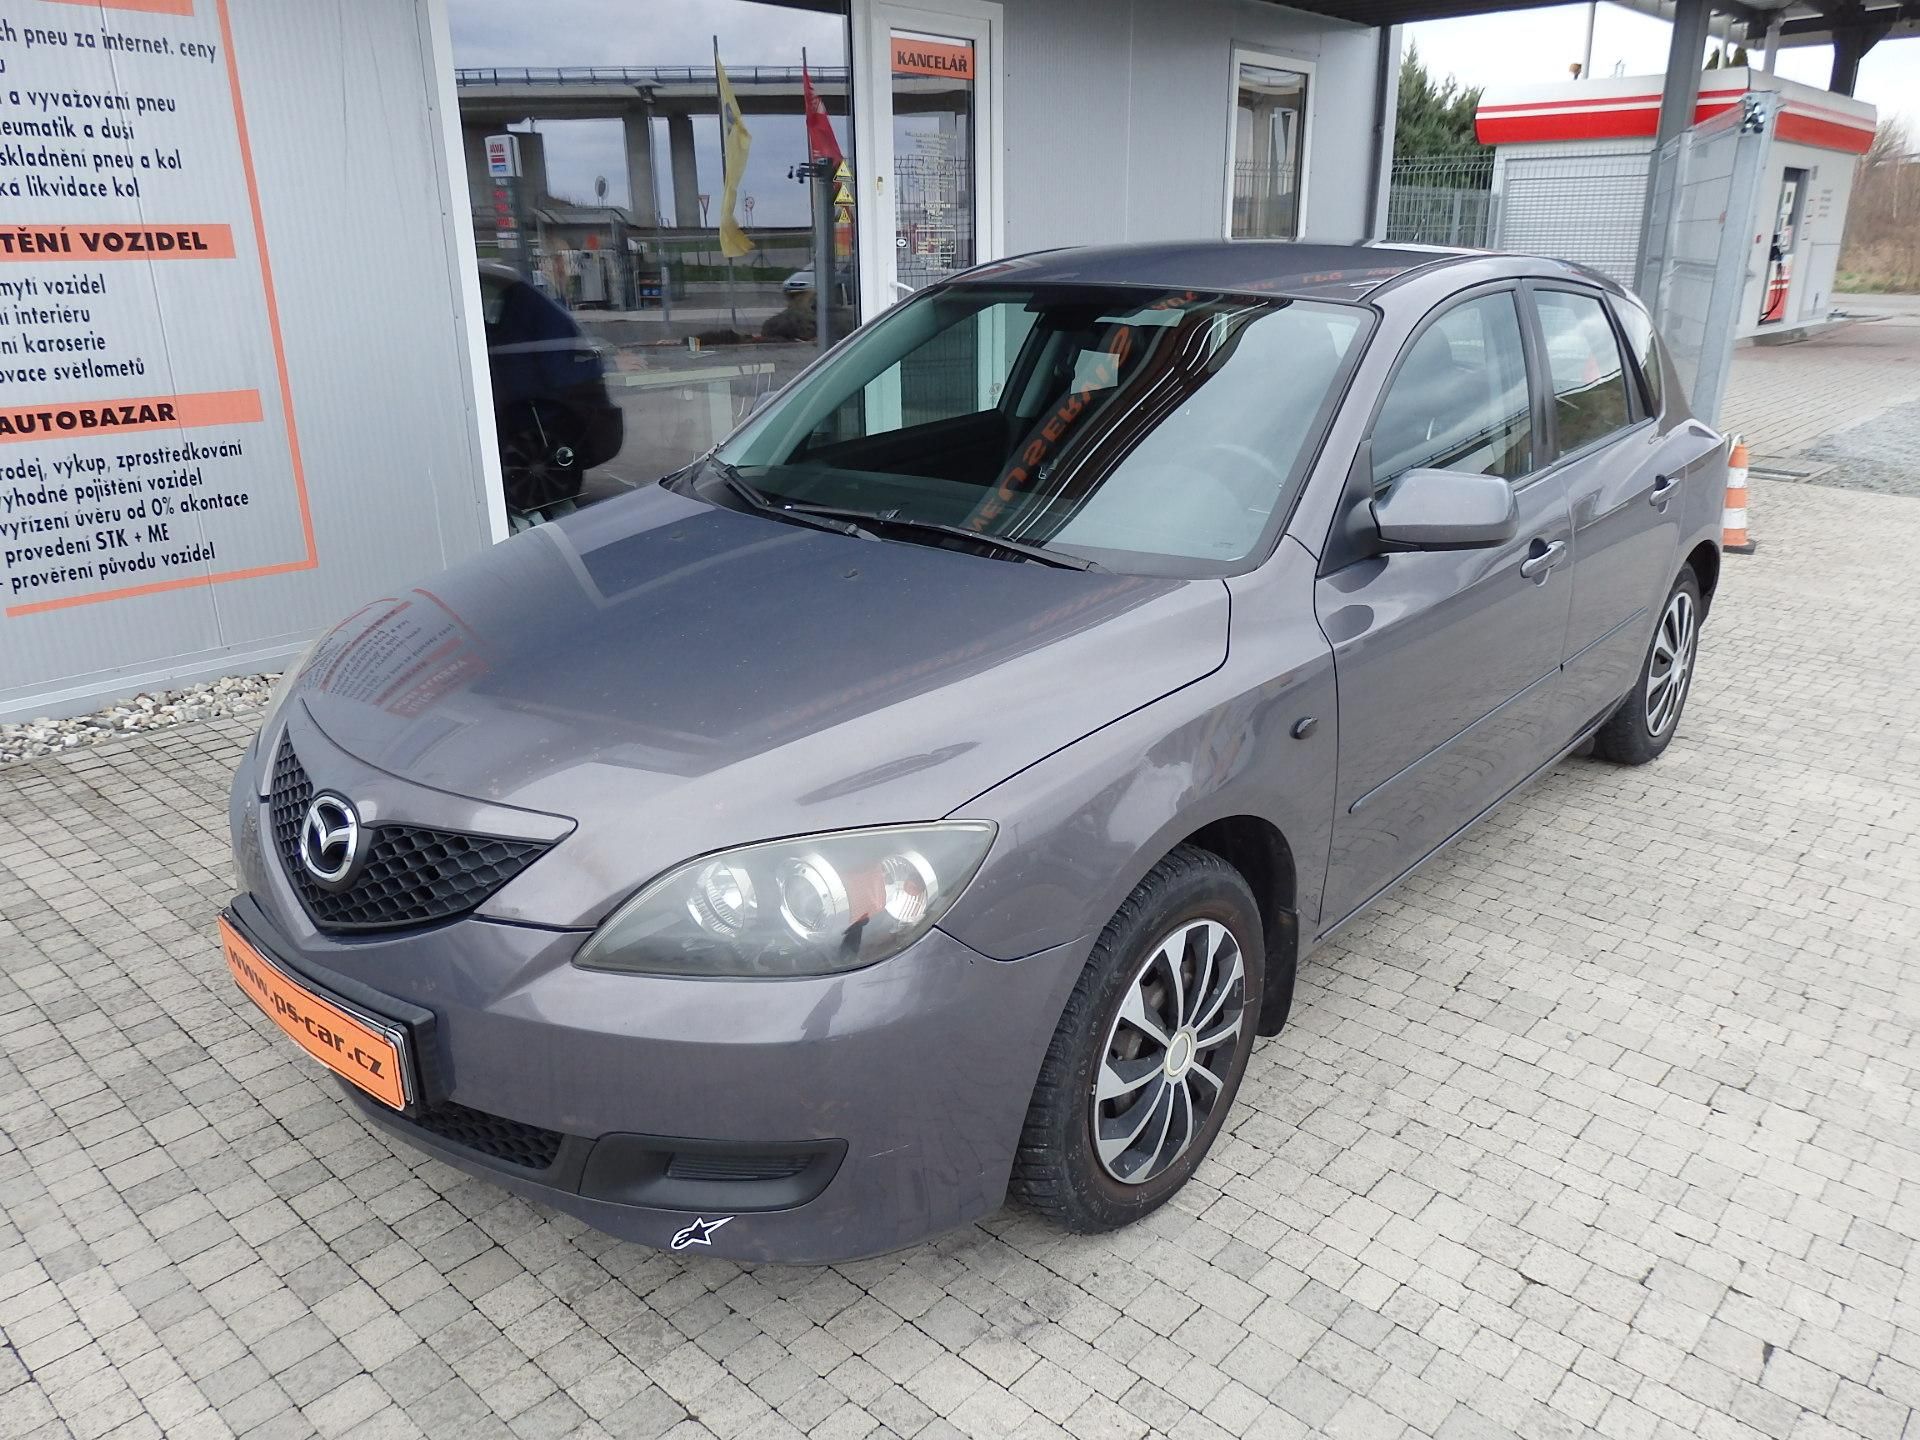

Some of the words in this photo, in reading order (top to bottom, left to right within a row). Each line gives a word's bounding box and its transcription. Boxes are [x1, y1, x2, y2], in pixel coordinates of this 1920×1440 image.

[24, 29, 68, 49] pneu
[74, 32, 96, 48] za
[101, 27, 174, 55] internet.
[180, 42, 216, 64] ceny
[897, 50, 967, 72] KANCELÁŘ
[9, 90, 21, 105] a
[27, 88, 130, 112] vyvažování
[136, 97, 176, 116] pneu
[0, 116, 77, 137] eumatik
[83, 124, 94, 138] a
[93, 154, 134, 173] pneu
[140, 156, 151, 169] a
[155, 148, 182, 169] kol
[26, 175, 107, 197] likvidace
[113, 176, 140, 197] kol
[79, 232, 208, 252] VOZIDEL
[44, 273, 106, 294] vozidel
[14, 303, 90, 325] interiéru
[22, 331, 106, 353] karoserie
[54, 357, 145, 380] světlometů
[0, 403, 176, 435] AUTOBAZAR
[53, 453, 111, 479] výkup,
[117, 438, 242, 473] zprostředkování
[0, 484, 68, 514] ýhodné
[74, 475, 142, 505] pojištění
[148, 467, 203, 491] vozidel
[0, 510, 70, 541] vyřízení
[75, 508, 121, 527] úvěru
[127, 500, 146, 520] od
[151, 496, 175, 517] 0%
[180, 493, 249, 513] akontace
[5, 534, 91, 569] provedení
[96, 528, 129, 551] STK
[134, 532, 142, 543] +
[148, 522, 170, 543] ME
[11, 561, 93, 595] prověření
[99, 551, 156, 581] původu
[161, 541, 216, 567] vozidel
[228, 945, 385, 1080] www.ps-car.cz
